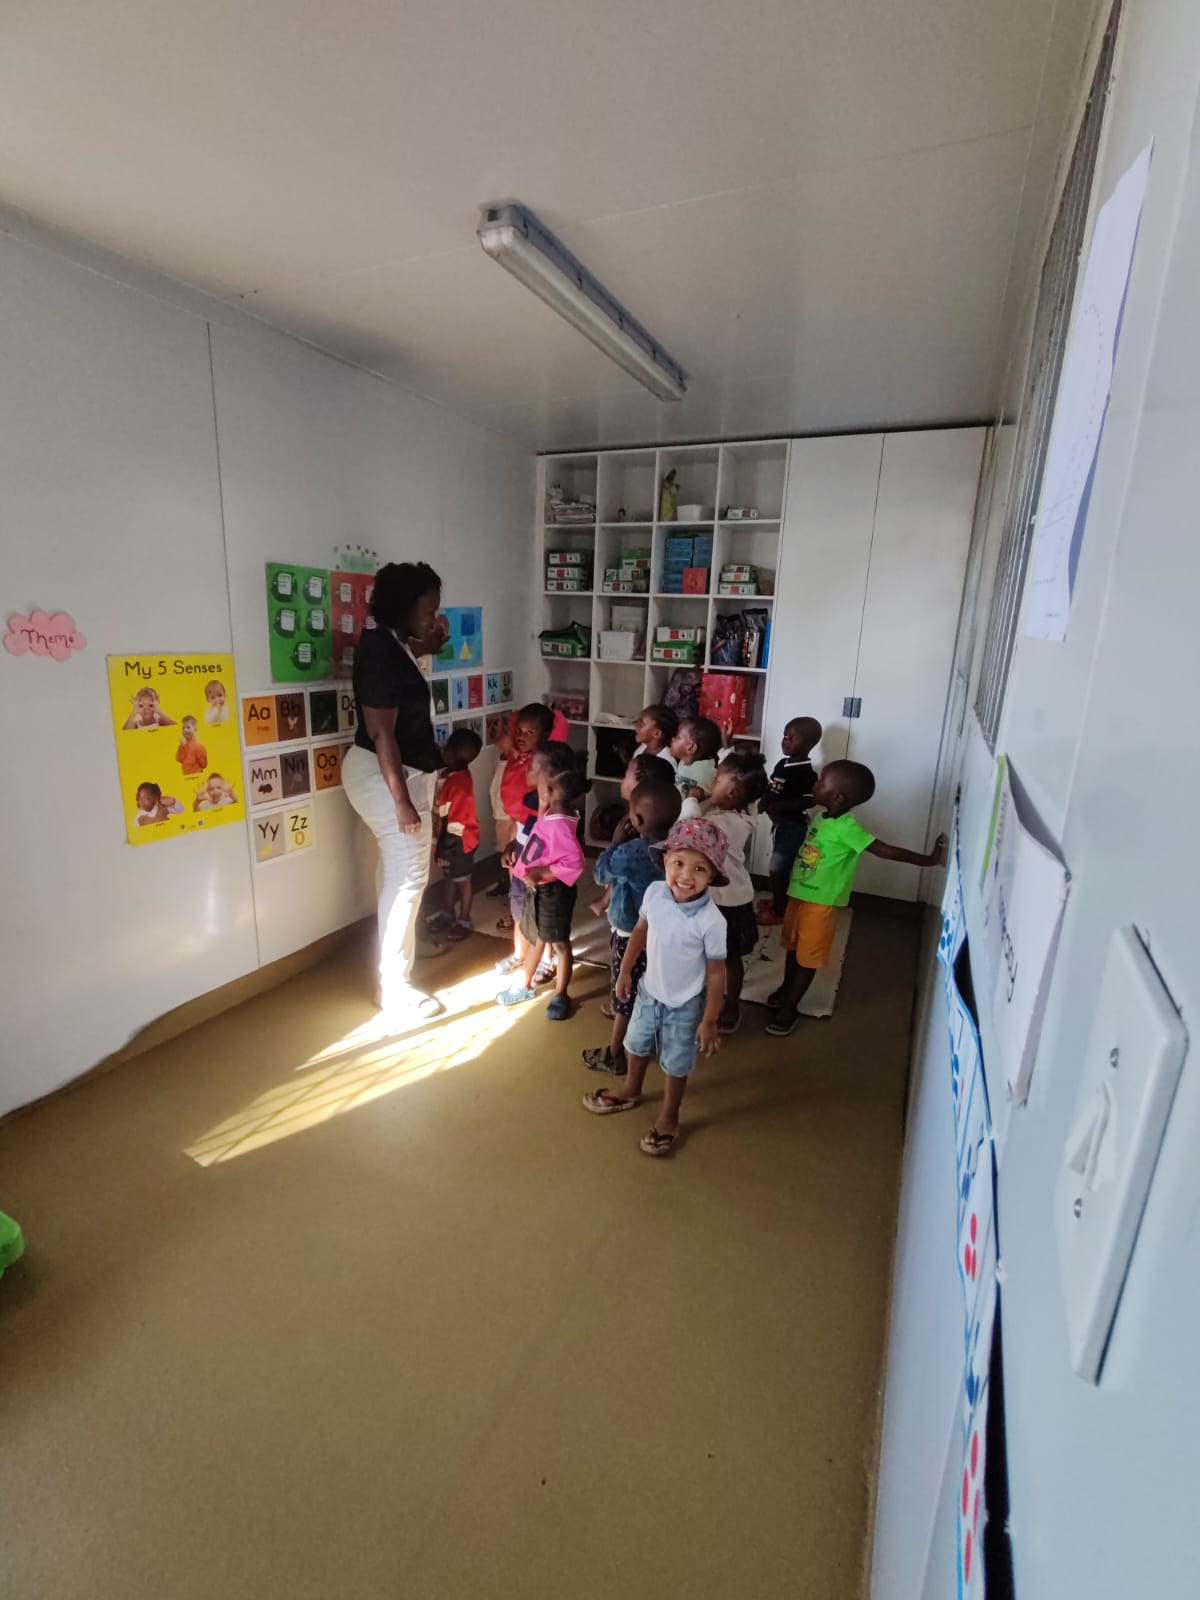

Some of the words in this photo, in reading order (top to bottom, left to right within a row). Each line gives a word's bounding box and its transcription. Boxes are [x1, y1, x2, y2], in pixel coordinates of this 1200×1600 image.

[124, 660, 152, 680] My
[158, 660, 167, 676] 5
[173, 659, 223, 675] Senses
[248, 703, 271, 722] Aa
[280, 700, 301, 717] Bb
[284, 757, 305, 775] Nn
[316, 753, 337, 769] Oo
[251, 767, 278, 783] Mm
[258, 821, 280, 842] Yy
[290, 814, 309, 832] Zz
